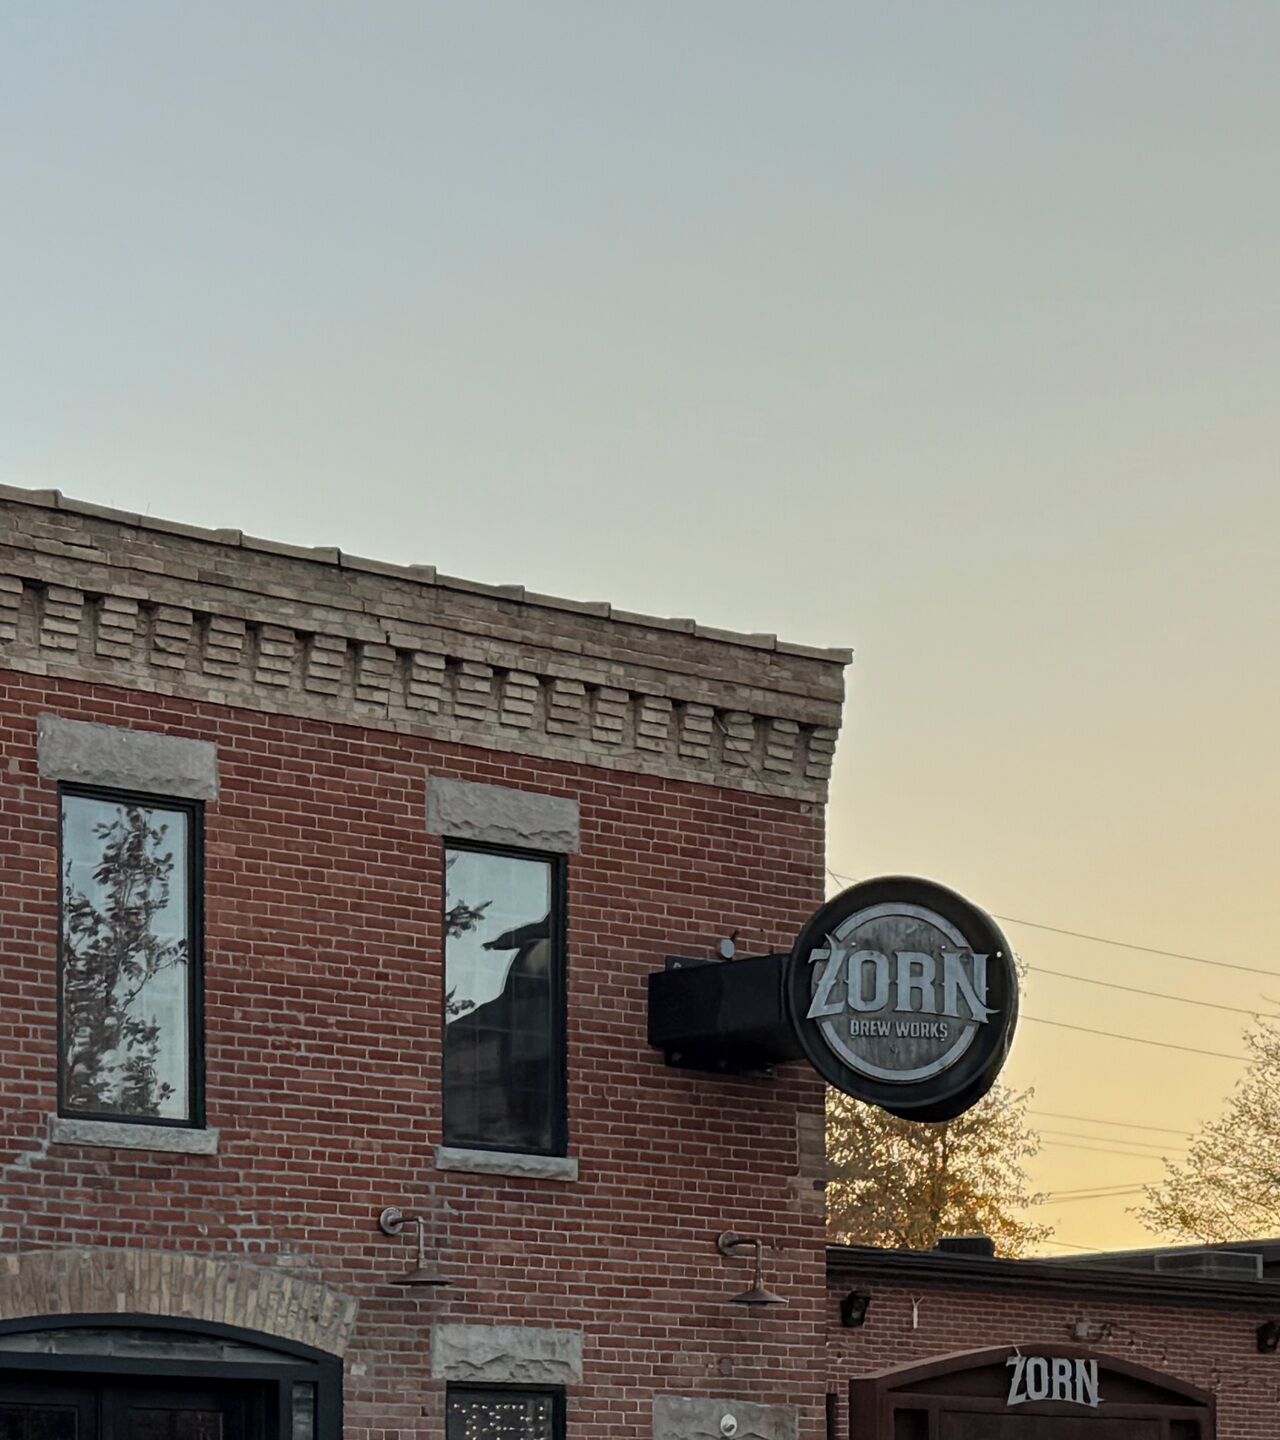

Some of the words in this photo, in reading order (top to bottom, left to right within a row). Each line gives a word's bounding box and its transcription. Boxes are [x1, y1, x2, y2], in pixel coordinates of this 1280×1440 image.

[806, 933, 1001, 1024] ZORN
[850, 1019, 890, 1039] BREW
[896, 1021, 948, 1040] WORKS
[1006, 1344, 1105, 1408] ZORN
